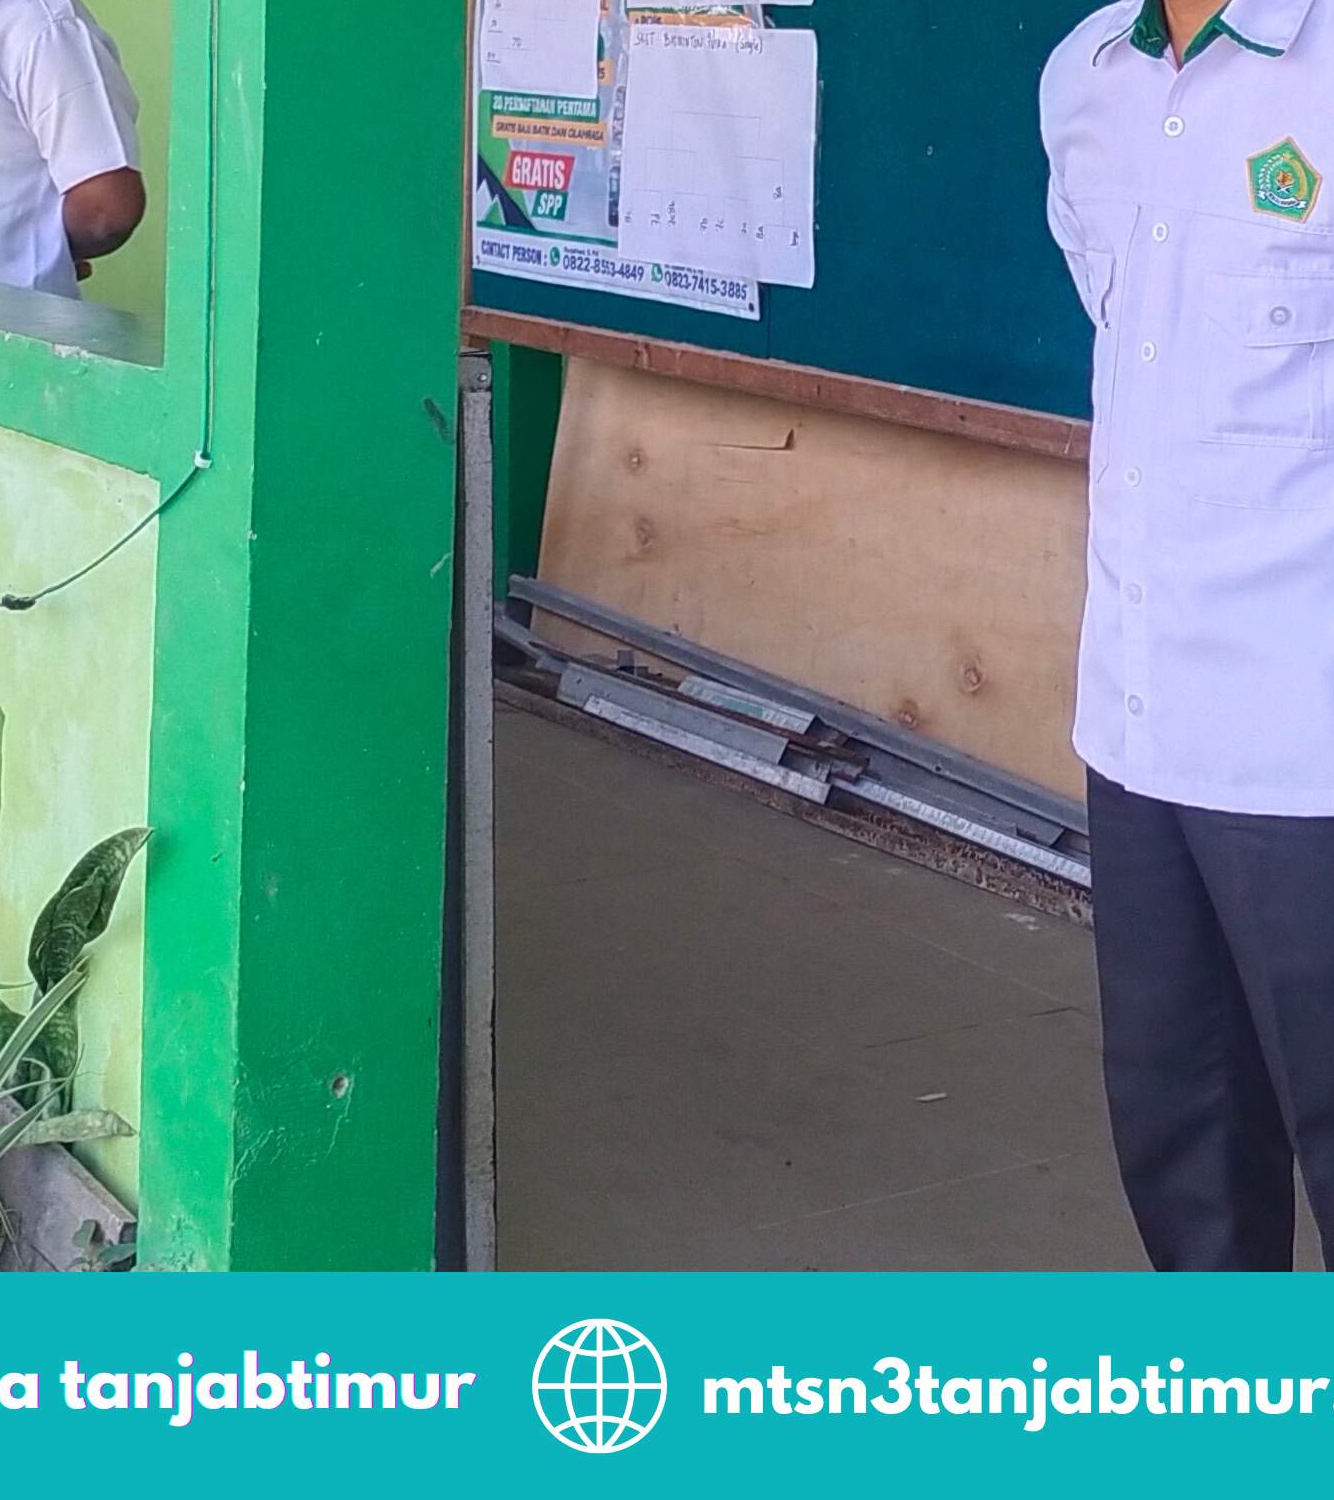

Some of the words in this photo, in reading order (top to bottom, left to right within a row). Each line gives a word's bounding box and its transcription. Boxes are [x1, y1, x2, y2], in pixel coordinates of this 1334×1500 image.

[511, 155, 566, 190] GRATIS
[537, 193, 563, 216] SPP
[481, 239, 510, 261] CONTACT
[512, 243, 542, 267] PERSON
